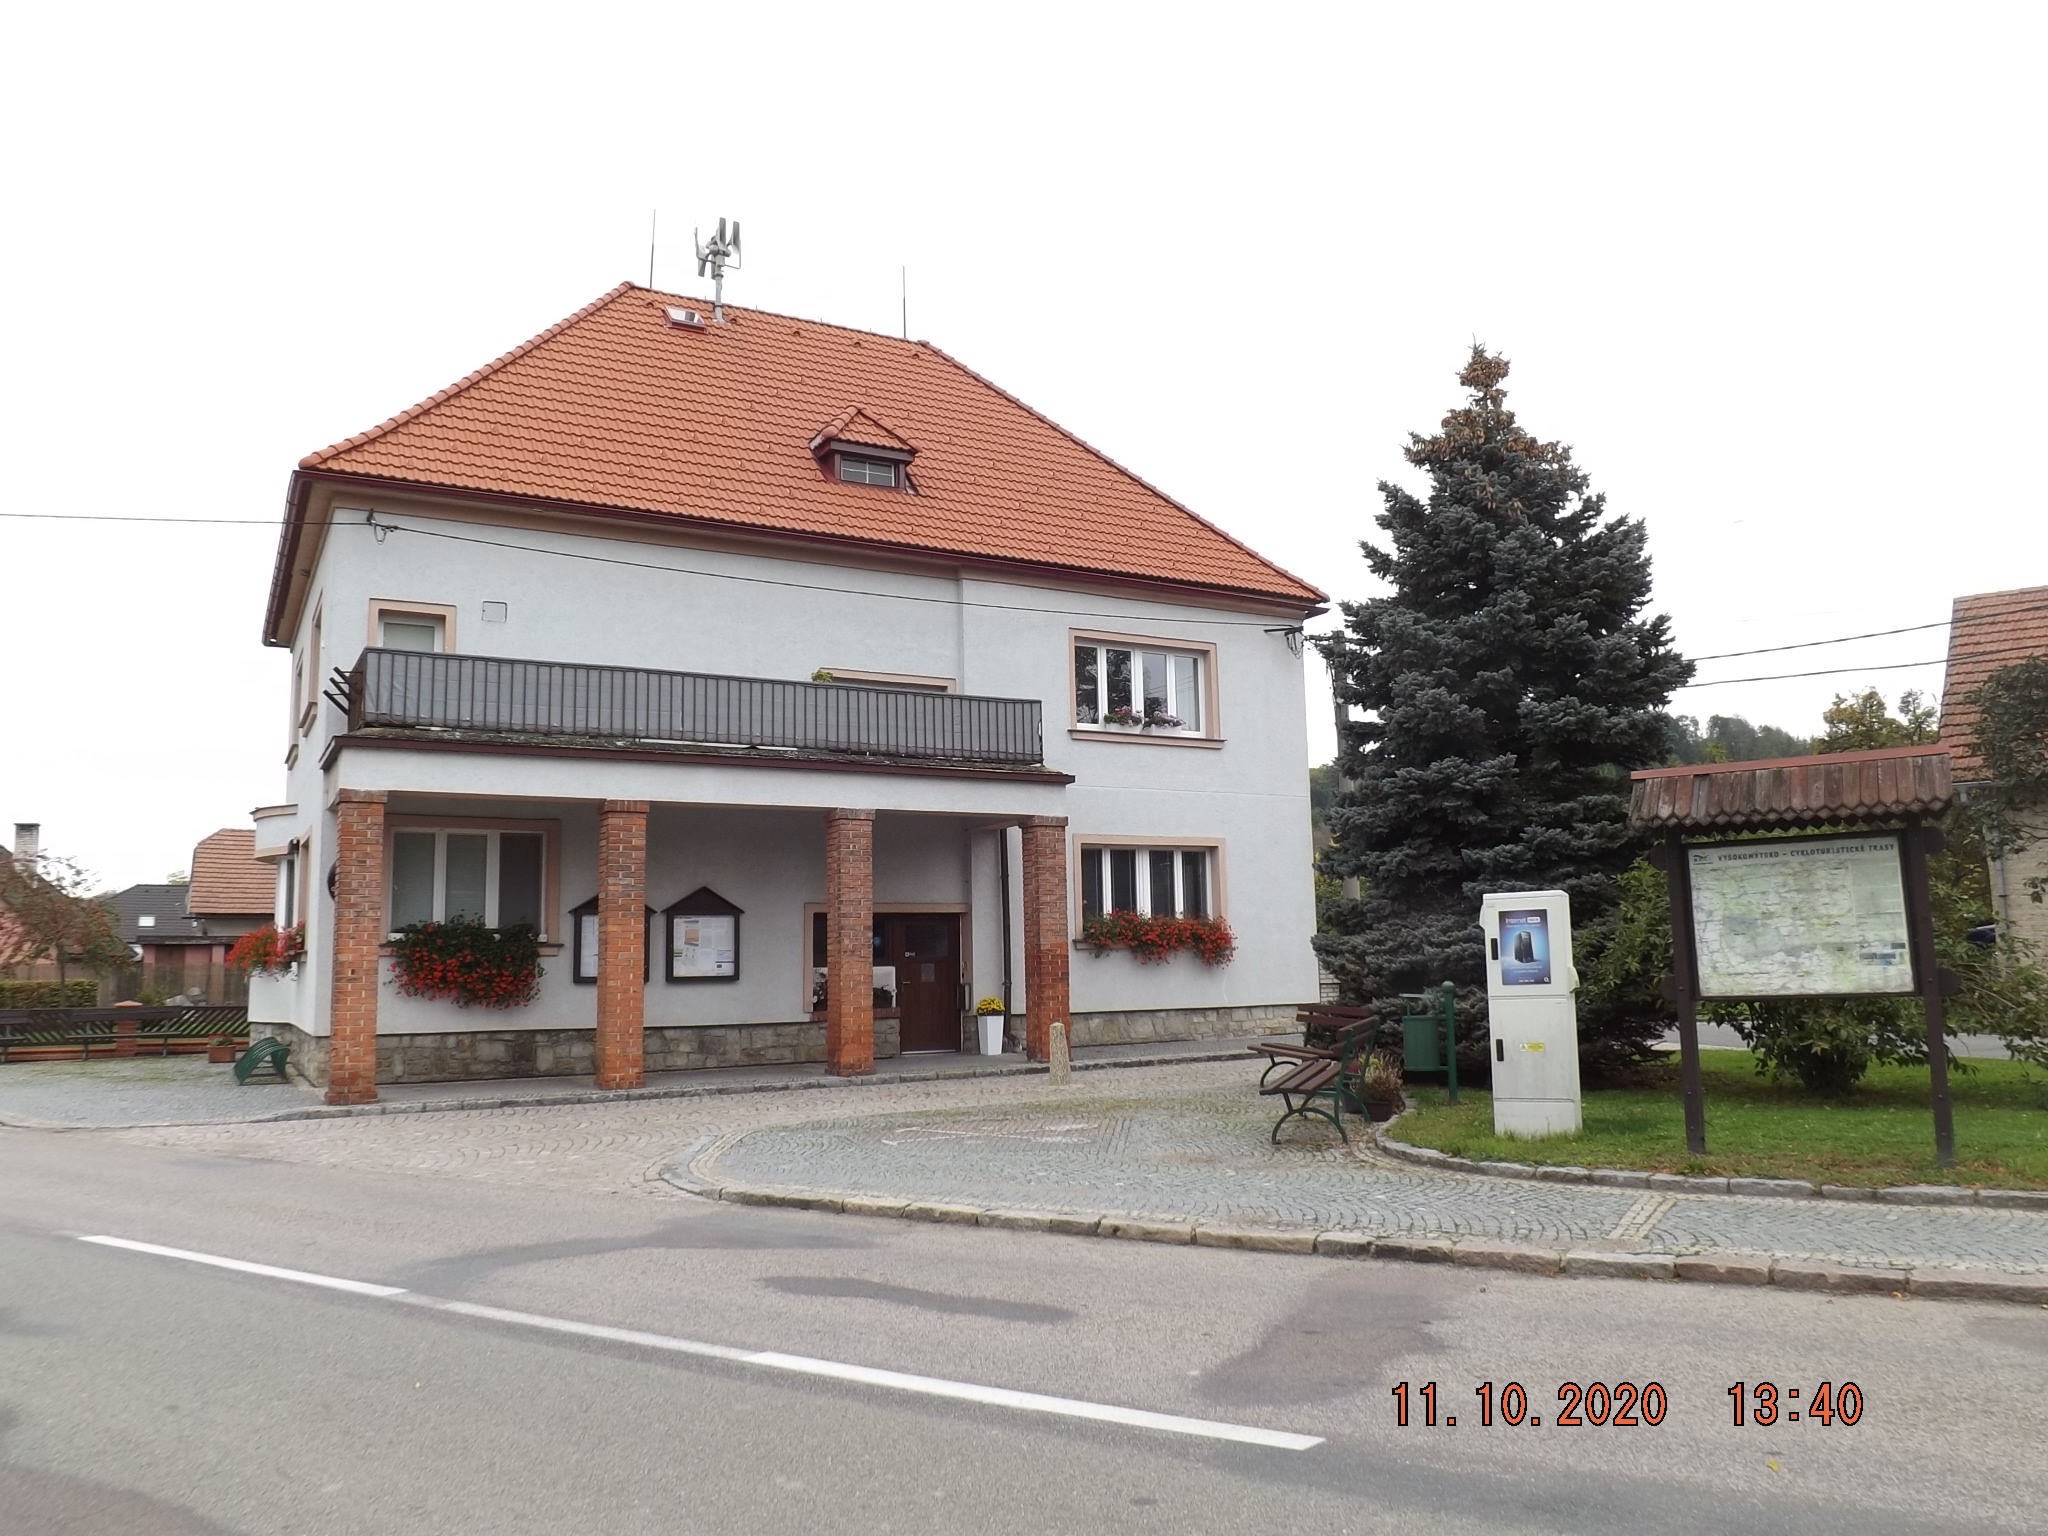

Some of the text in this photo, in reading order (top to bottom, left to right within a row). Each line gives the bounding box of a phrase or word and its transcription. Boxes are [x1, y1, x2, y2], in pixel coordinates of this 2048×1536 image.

[1718, 851, 1779, 861] VYSOKOMÝTSKO
[1790, 844, 1865, 857] CYKLOTURISTICKÉ
[1868, 844, 1895, 853] TRASY
